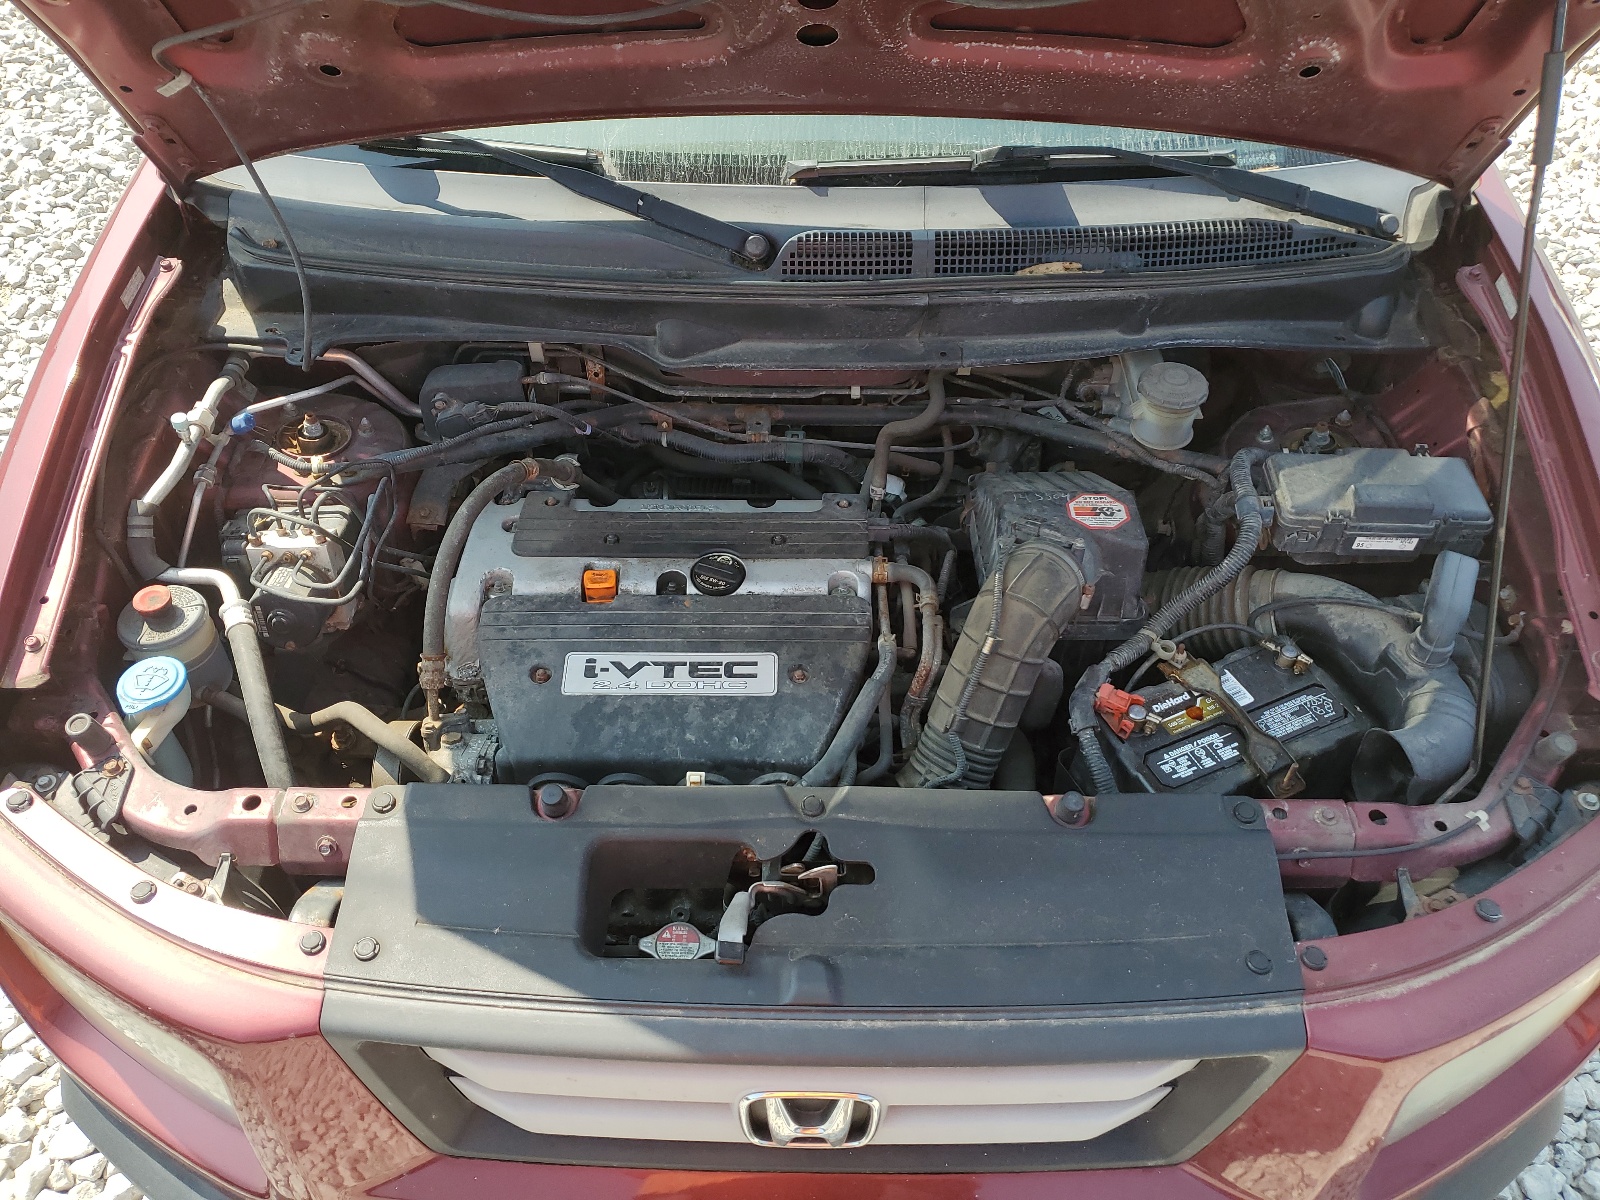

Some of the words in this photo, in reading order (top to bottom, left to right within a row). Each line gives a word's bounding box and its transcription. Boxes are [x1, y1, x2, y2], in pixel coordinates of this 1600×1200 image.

[583, 657, 759, 679] i-VTEC
[592, 680, 639, 690] 2.4
[645, 680, 748, 690] DOHC
[1152, 691, 1191, 713] DieHard
[1169, 743, 1194, 757] DANGER
[1197, 732, 1220, 745] POISON
